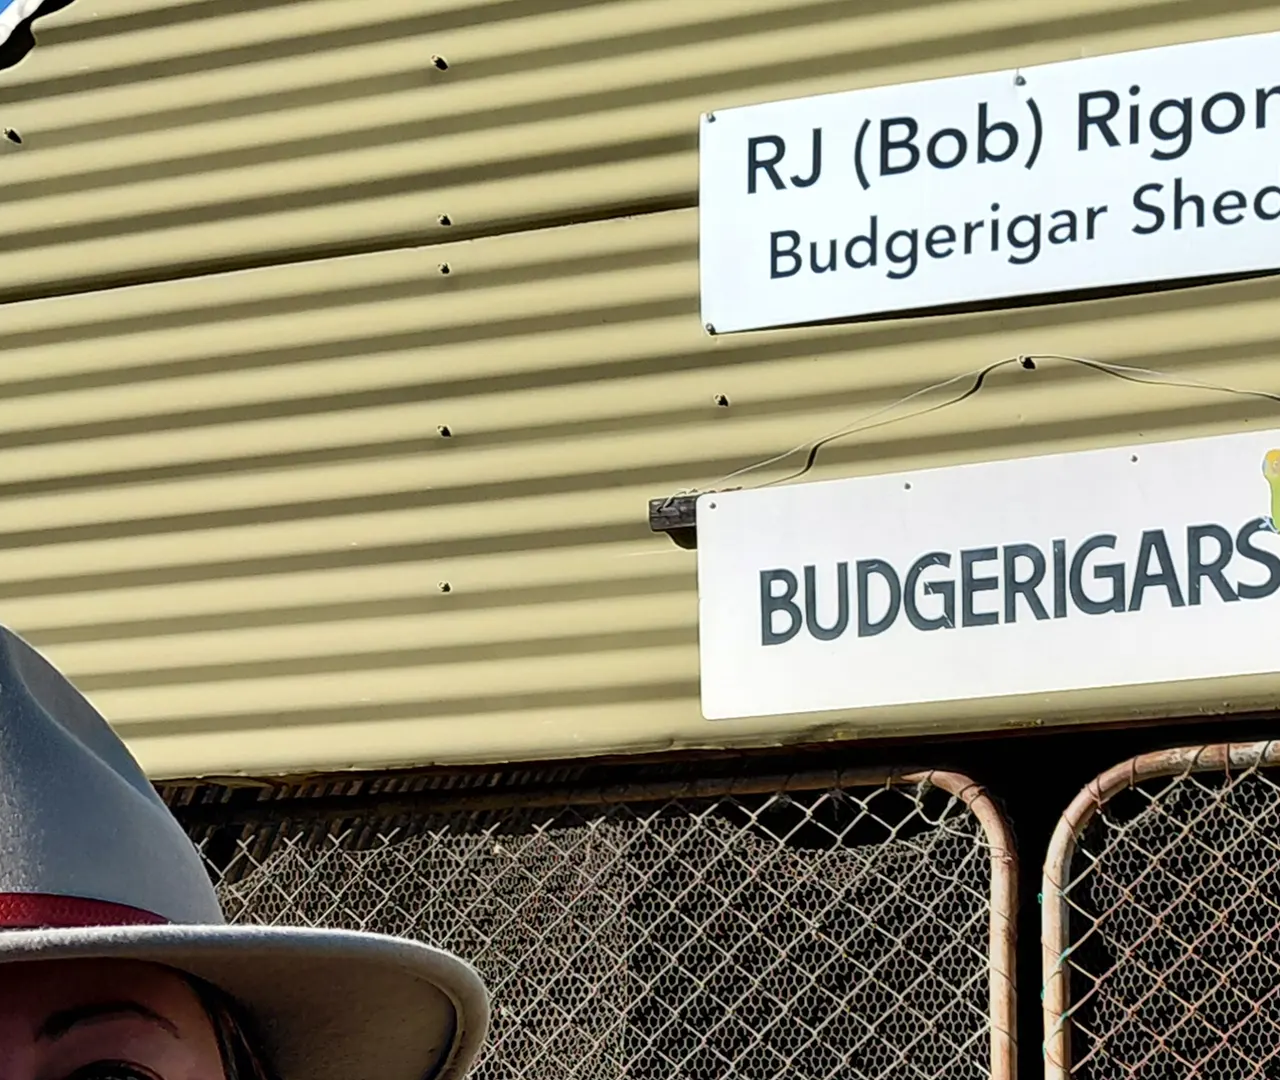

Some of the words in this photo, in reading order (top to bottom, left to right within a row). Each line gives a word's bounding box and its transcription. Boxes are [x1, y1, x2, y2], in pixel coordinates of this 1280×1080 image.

[747, 127, 822, 194] RJ
[854, 97, 1043, 191] (Bob)
[770, 203, 1108, 280] Budgerigar
